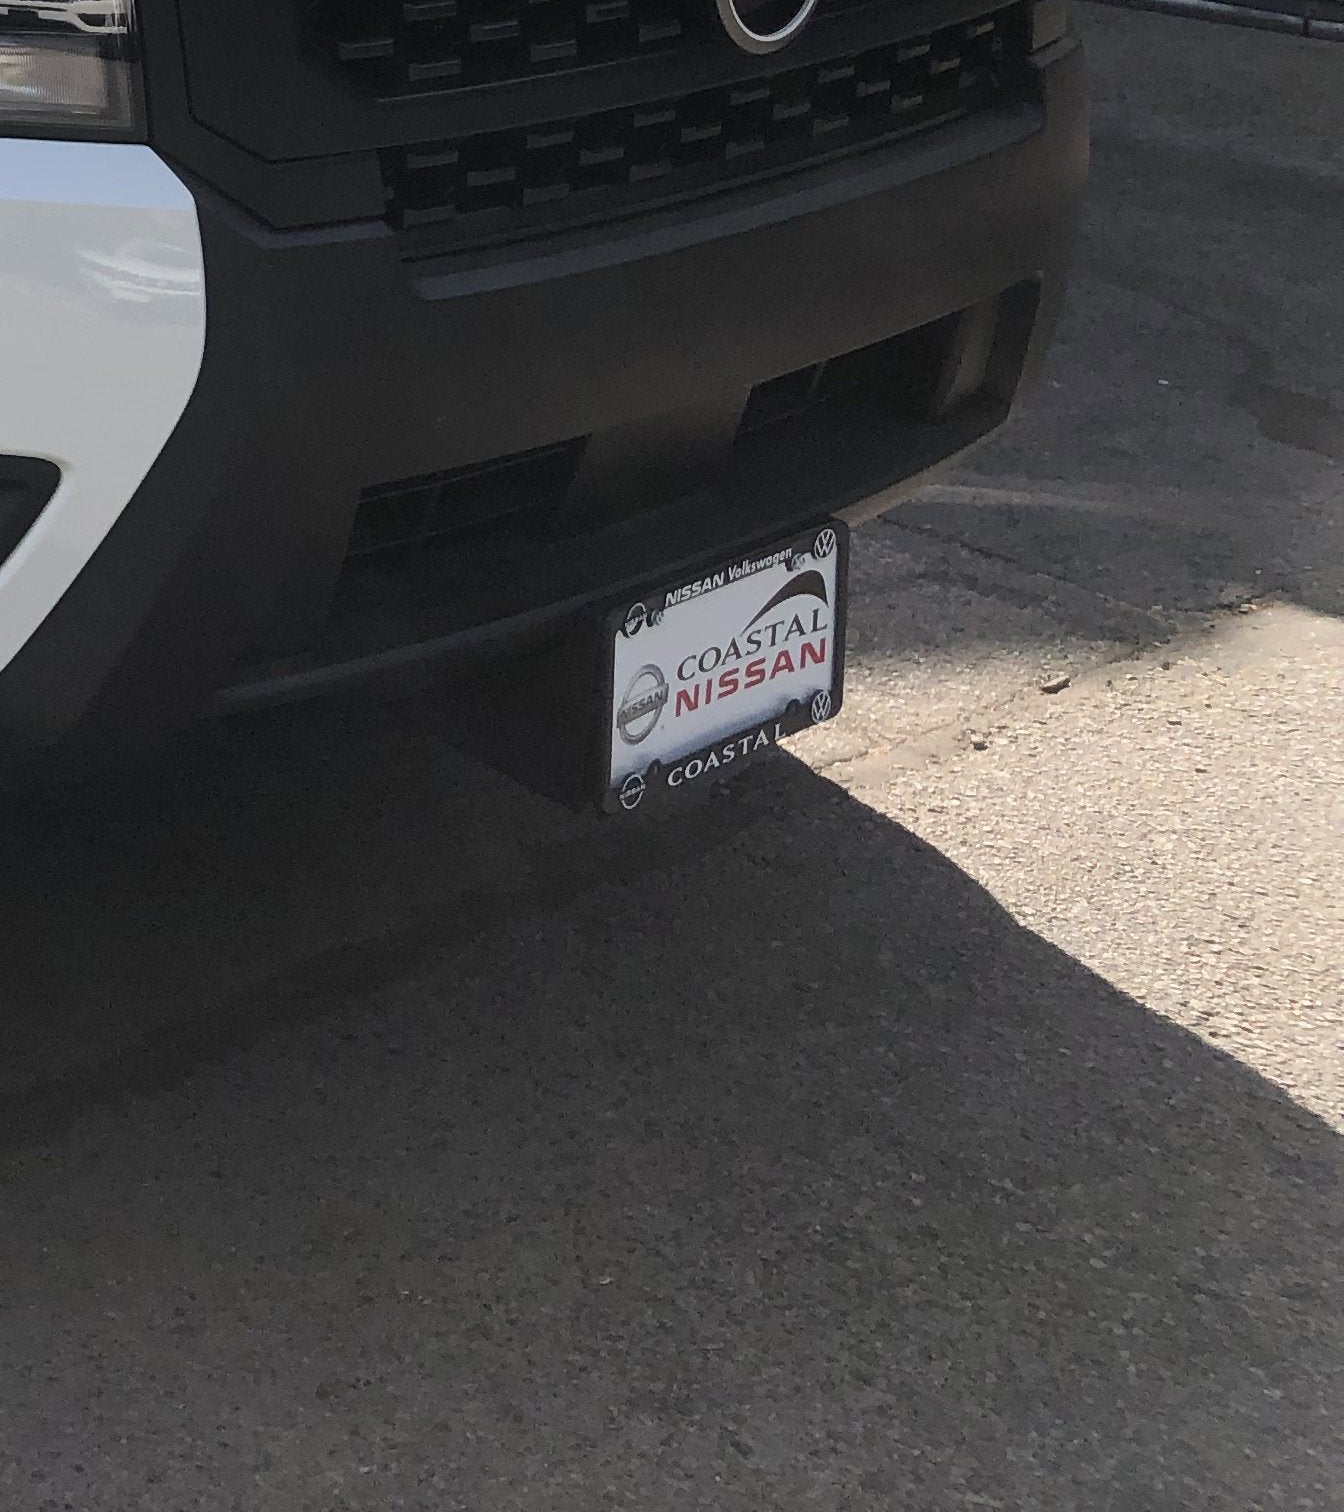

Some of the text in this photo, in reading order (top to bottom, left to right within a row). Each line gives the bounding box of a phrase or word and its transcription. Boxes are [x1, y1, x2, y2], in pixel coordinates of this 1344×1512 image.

[665, 548, 792, 607] NISSAN Volkswagen
[675, 638, 826, 717] NISSAN
[677, 608, 828, 681] COASTAL
[667, 723, 786, 787] COASTAL
